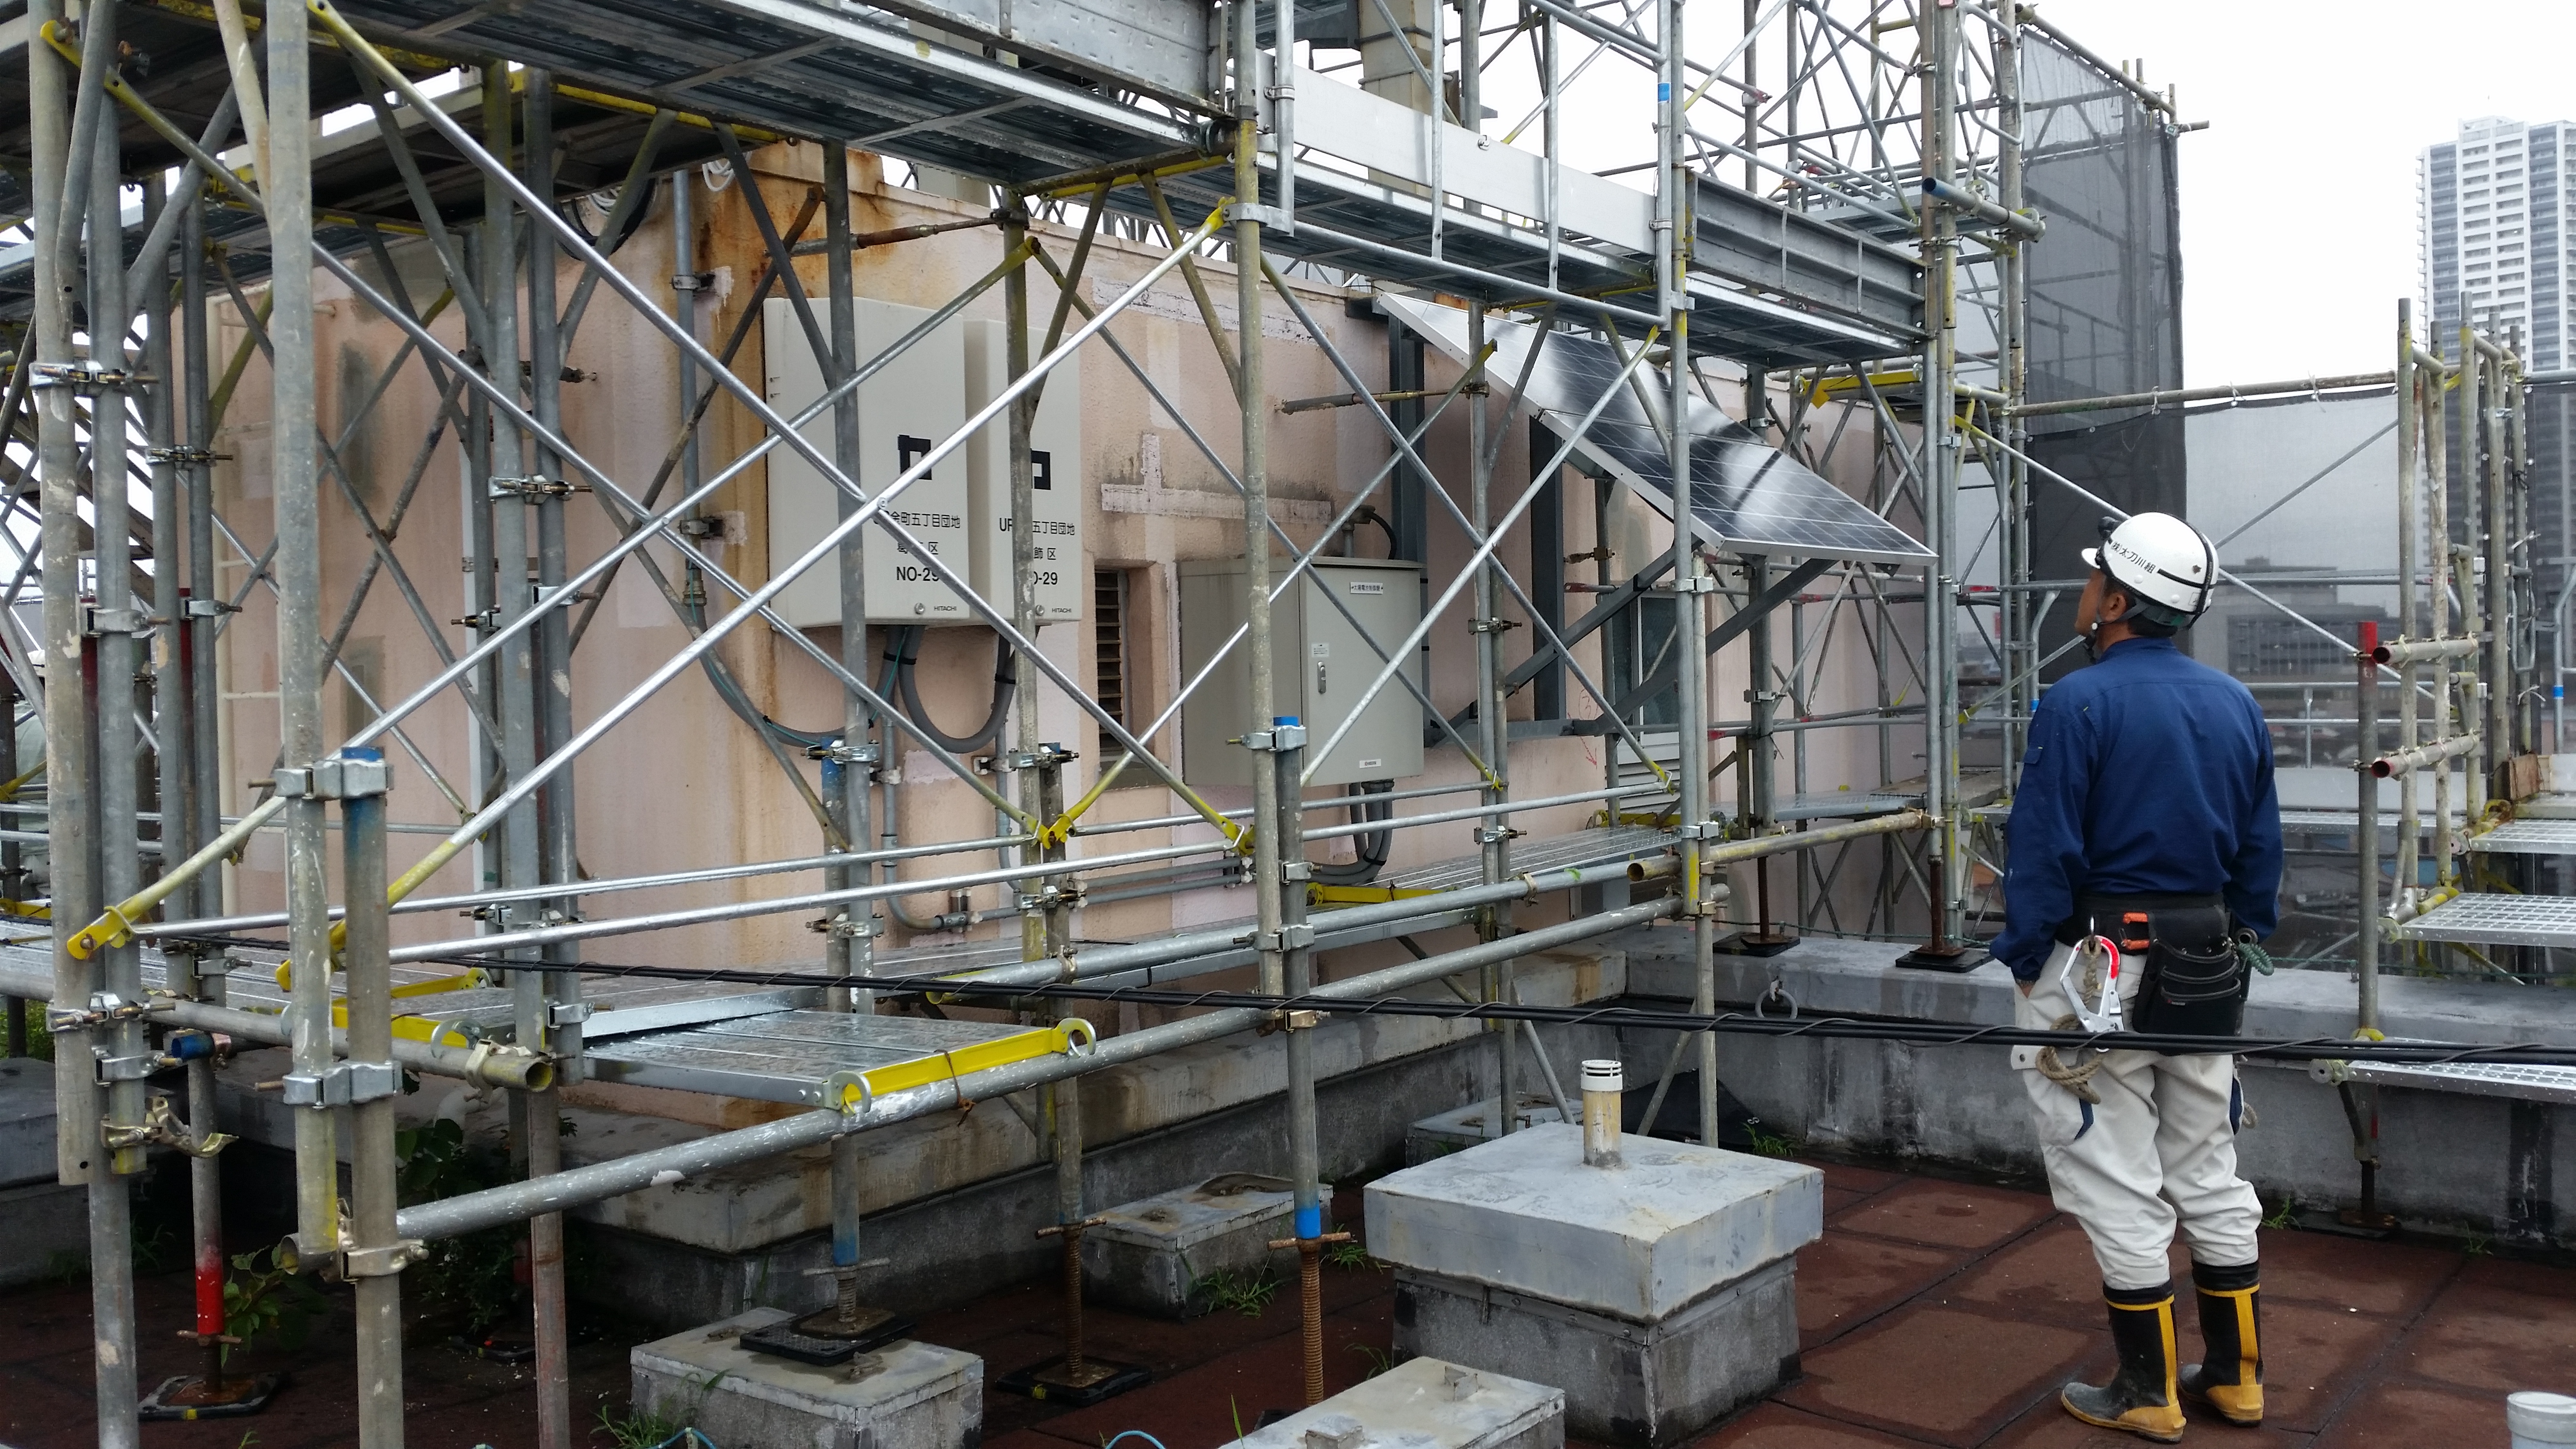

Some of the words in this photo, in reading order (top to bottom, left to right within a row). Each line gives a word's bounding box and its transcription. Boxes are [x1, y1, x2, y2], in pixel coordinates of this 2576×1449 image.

[873, 510, 960, 529] 金町五丁目団地
[1033, 547, 1056, 560] 飾区
